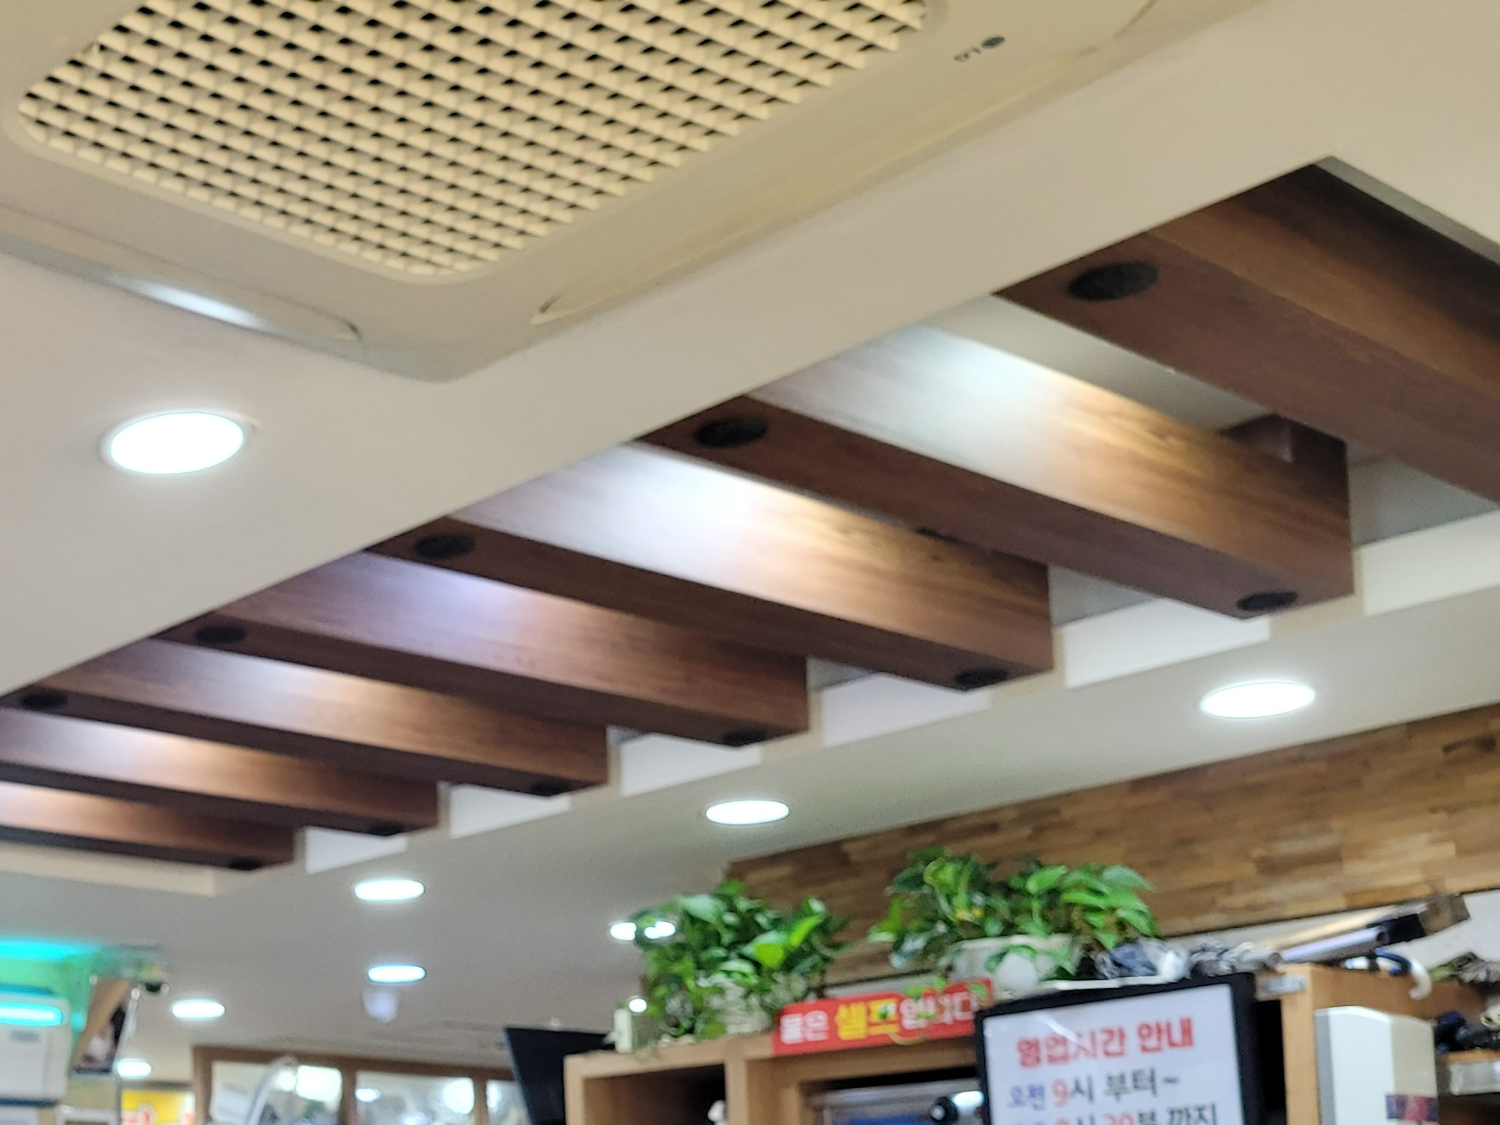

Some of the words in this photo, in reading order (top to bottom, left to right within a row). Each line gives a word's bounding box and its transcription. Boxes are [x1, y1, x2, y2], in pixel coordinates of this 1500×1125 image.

[779, 1010, 828, 1044] 물은
[1016, 1026, 1127, 1069] 영업시간
[1137, 1016, 1195, 1054] 안내
[1008, 1083, 1046, 1110] 오전
[1052, 1075, 1094, 1109] 9시
